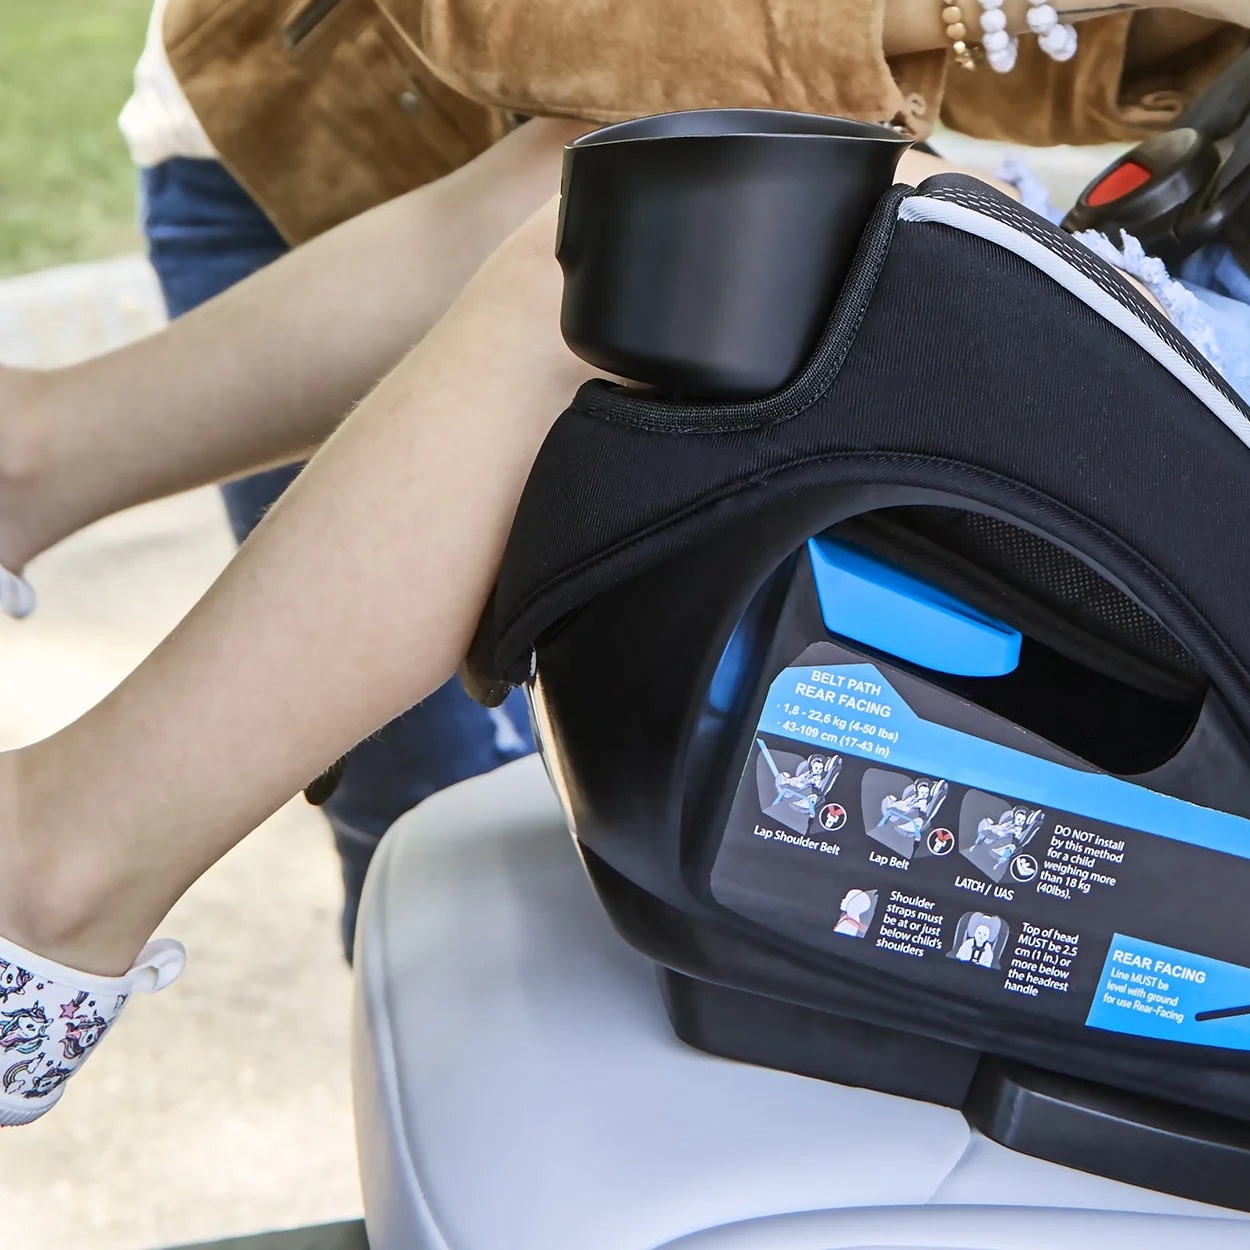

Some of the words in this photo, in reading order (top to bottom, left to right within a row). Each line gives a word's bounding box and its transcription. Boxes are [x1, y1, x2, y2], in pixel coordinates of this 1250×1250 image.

[811, 670, 845, 687] BELT
[847, 678, 881, 695] PATH
[795, 682, 836, 703] REAR
[838, 694, 891, 717] FACING
[784, 703, 800, 715] 1,8
[807, 709, 831, 723] 22,6
[832, 716, 847, 730] kg
[848, 720, 876, 735] (4-50
[877, 727, 898, 743] lbs)
[782, 720, 819, 738] 43-109
[820, 732, 837, 742] cm
[839, 735, 873, 752] (17-43
[874, 744, 889, 758] in)
[754, 825, 773, 839] Lap
[773, 830, 819, 849] Shoulder
[820, 841, 840, 855] Belt
[1054, 824, 1071, 836] DO
[1072, 829, 1095, 842] NOT
[1094, 835, 1124, 850] install
[869, 851, 888, 865] Lap
[889, 856, 909, 870] Belt
[1047, 847, 1062, 858] for
[1062, 853, 1069, 861] a
[1070, 854, 1095, 867] child
[1050, 836, 1064, 849] by
[1065, 840, 1083, 852] this
[1084, 847, 1124, 863] method
[1040, 870, 1062, 884] than
[1065, 877, 1077, 887] 18
[1077, 879, 1091, 893] kg
[1044, 860, 1089, 880] weighing
[1090, 873, 1116, 886] more
[954, 876, 985, 892] LATCH
[994, 886, 1014, 900] UAS
[1036, 882, 1070, 899] (40lbs).
[889, 891, 935, 909] Shoulder
[883, 913, 896, 925] be
[897, 919, 908, 928] at
[909, 922, 921, 930] or
[920, 923, 941, 936] just
[885, 904, 916, 918] straps
[917, 912, 943, 924] must
[879, 924, 911, 940] below
[1020, 922, 1040, 939] Top
[1041, 928, 1054, 938] of
[1053, 930, 1079, 944] head
[876, 937, 924, 956] shoulders
[1017, 933, 1048, 948] MUST
[1048, 941, 1061, 953] be
[1062, 945, 1078, 956] 2.5
[1014, 947, 1030, 957] cm
[1031, 949, 1041, 960] (1
[1042, 952, 1058, 965] in.)
[1059, 958, 1071, 966] or
[1112, 949, 1152, 970] REAR
[1154, 960, 1206, 983] FACING
[1008, 969, 1025, 980] the
[1026, 972, 1068, 991] headrest
[1011, 959, 1037, 971] more
[1038, 963, 1069, 978] below
[1110, 967, 1129, 980] Line
[1130, 972, 1158, 987] MUST
[1157, 979, 1169, 990] be
[1004, 979, 1038, 996] handle
